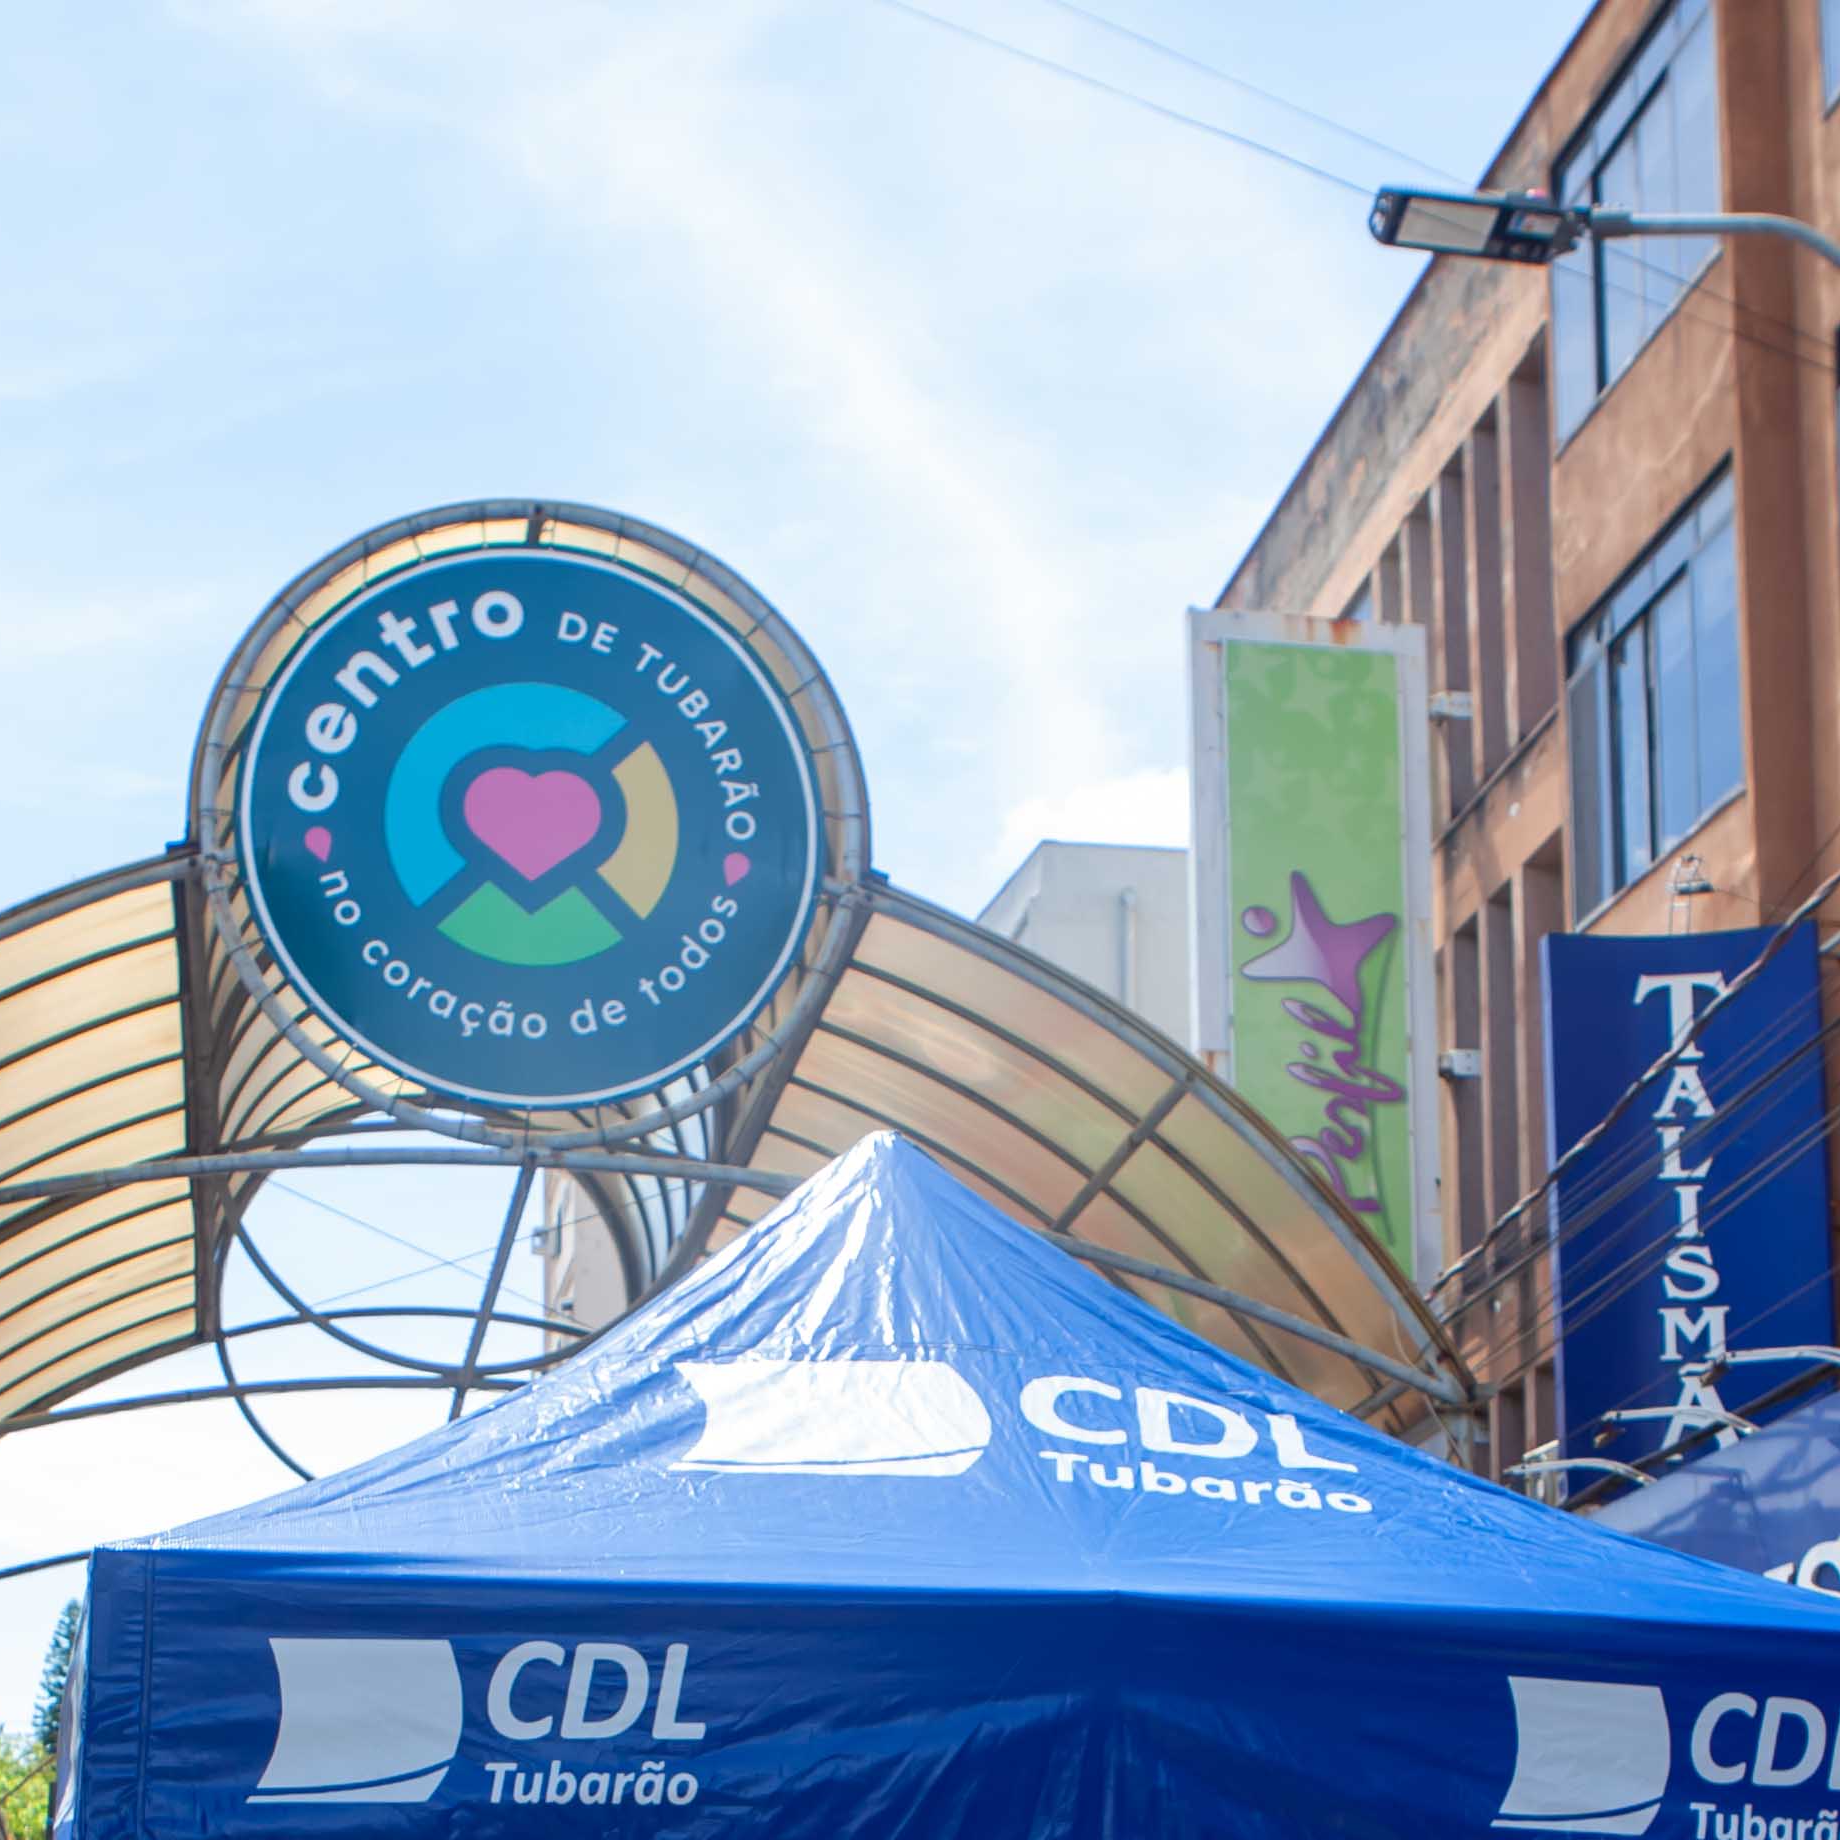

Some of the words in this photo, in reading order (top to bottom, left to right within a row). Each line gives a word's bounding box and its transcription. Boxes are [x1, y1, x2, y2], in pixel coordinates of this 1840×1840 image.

[288, 590, 523, 812] centro
[557, 610, 618, 655] DE
[634, 643, 761, 841] TUBARÃO
[318, 868, 361, 927] no
[362, 938, 547, 1040] coração
[569, 999, 628, 1037] de
[638, 894, 738, 1008] todos
[1020, 1375, 1359, 1474] CDL
[1040, 1450, 1373, 1513] Tubarão
[486, 1640, 707, 1741] CDL
[484, 1759, 700, 1807] Tubarão
